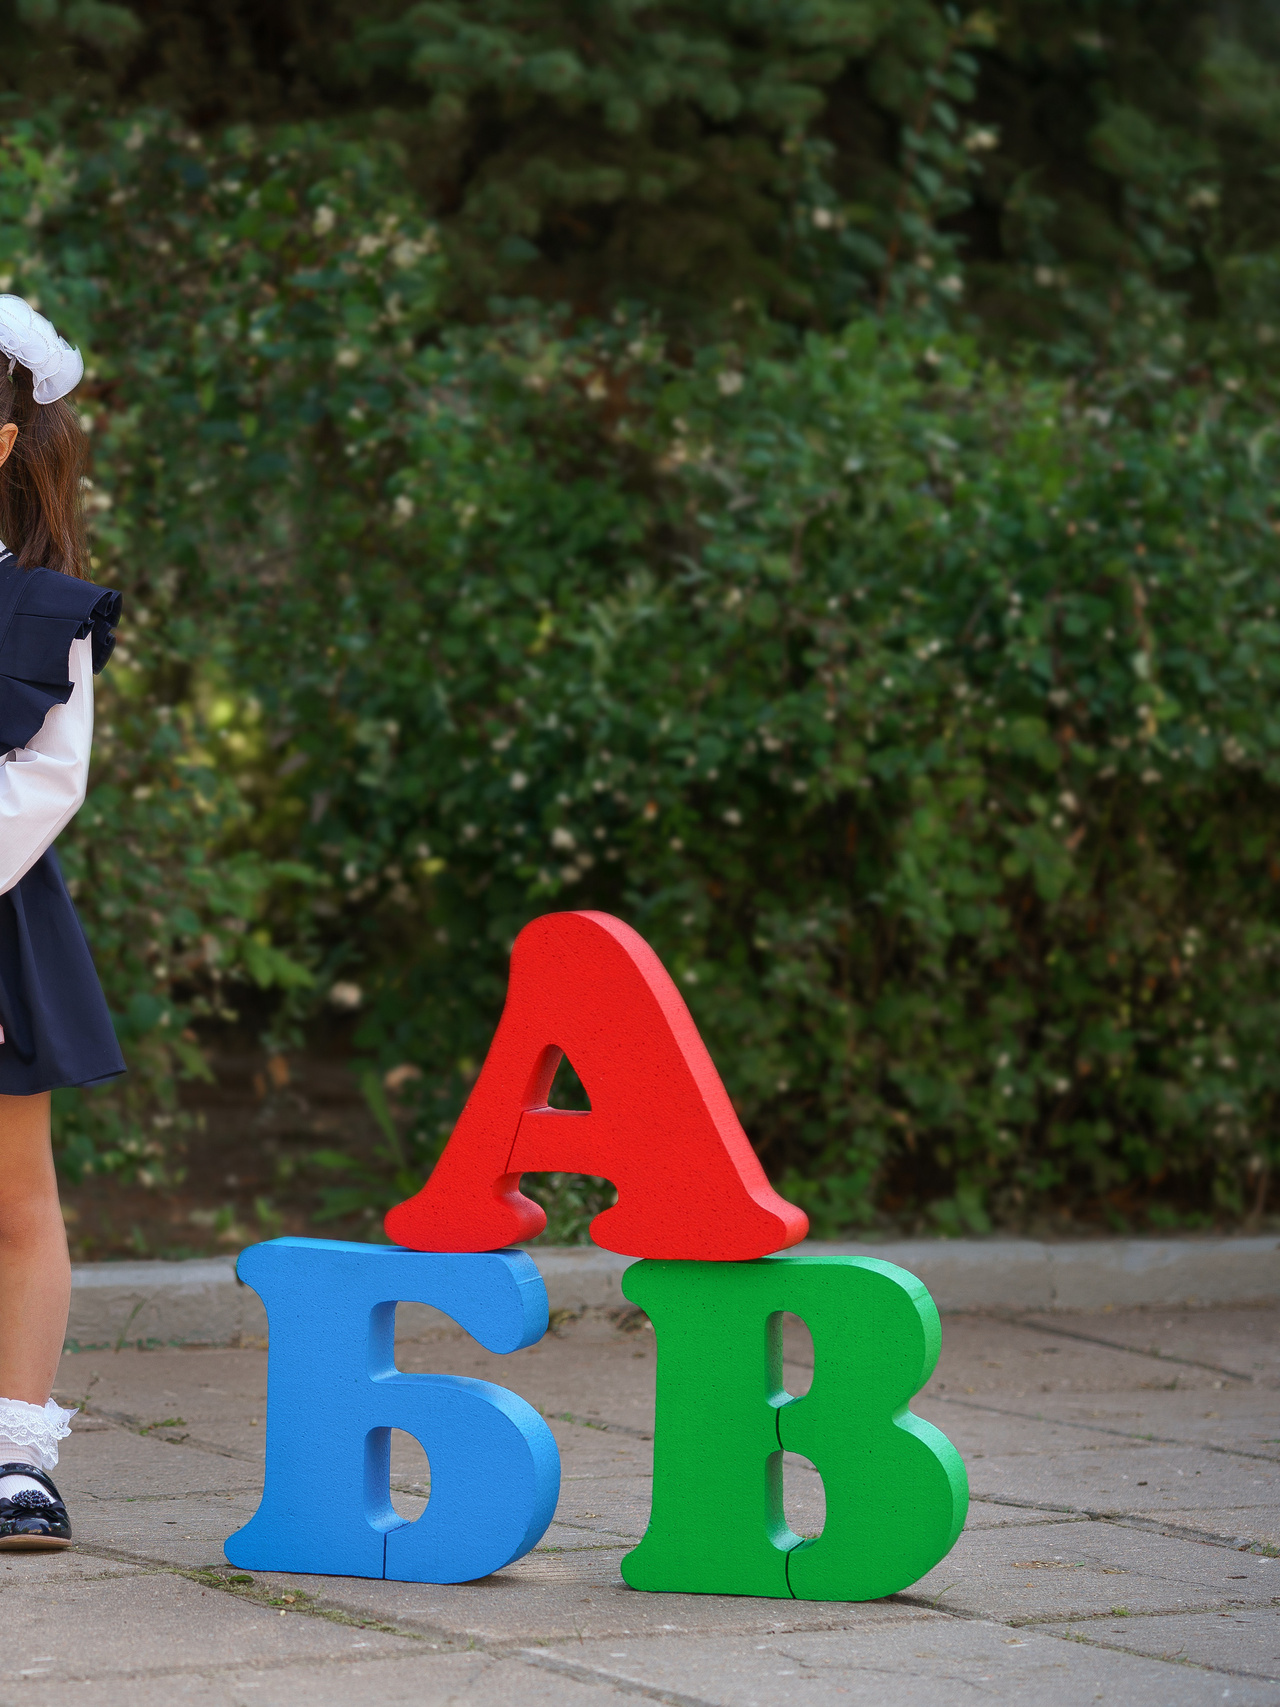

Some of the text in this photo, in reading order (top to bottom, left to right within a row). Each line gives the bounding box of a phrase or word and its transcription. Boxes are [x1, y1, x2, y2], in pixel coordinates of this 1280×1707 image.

[384, 910, 809, 1261] А
[223, 1237, 969, 1602] Б В
